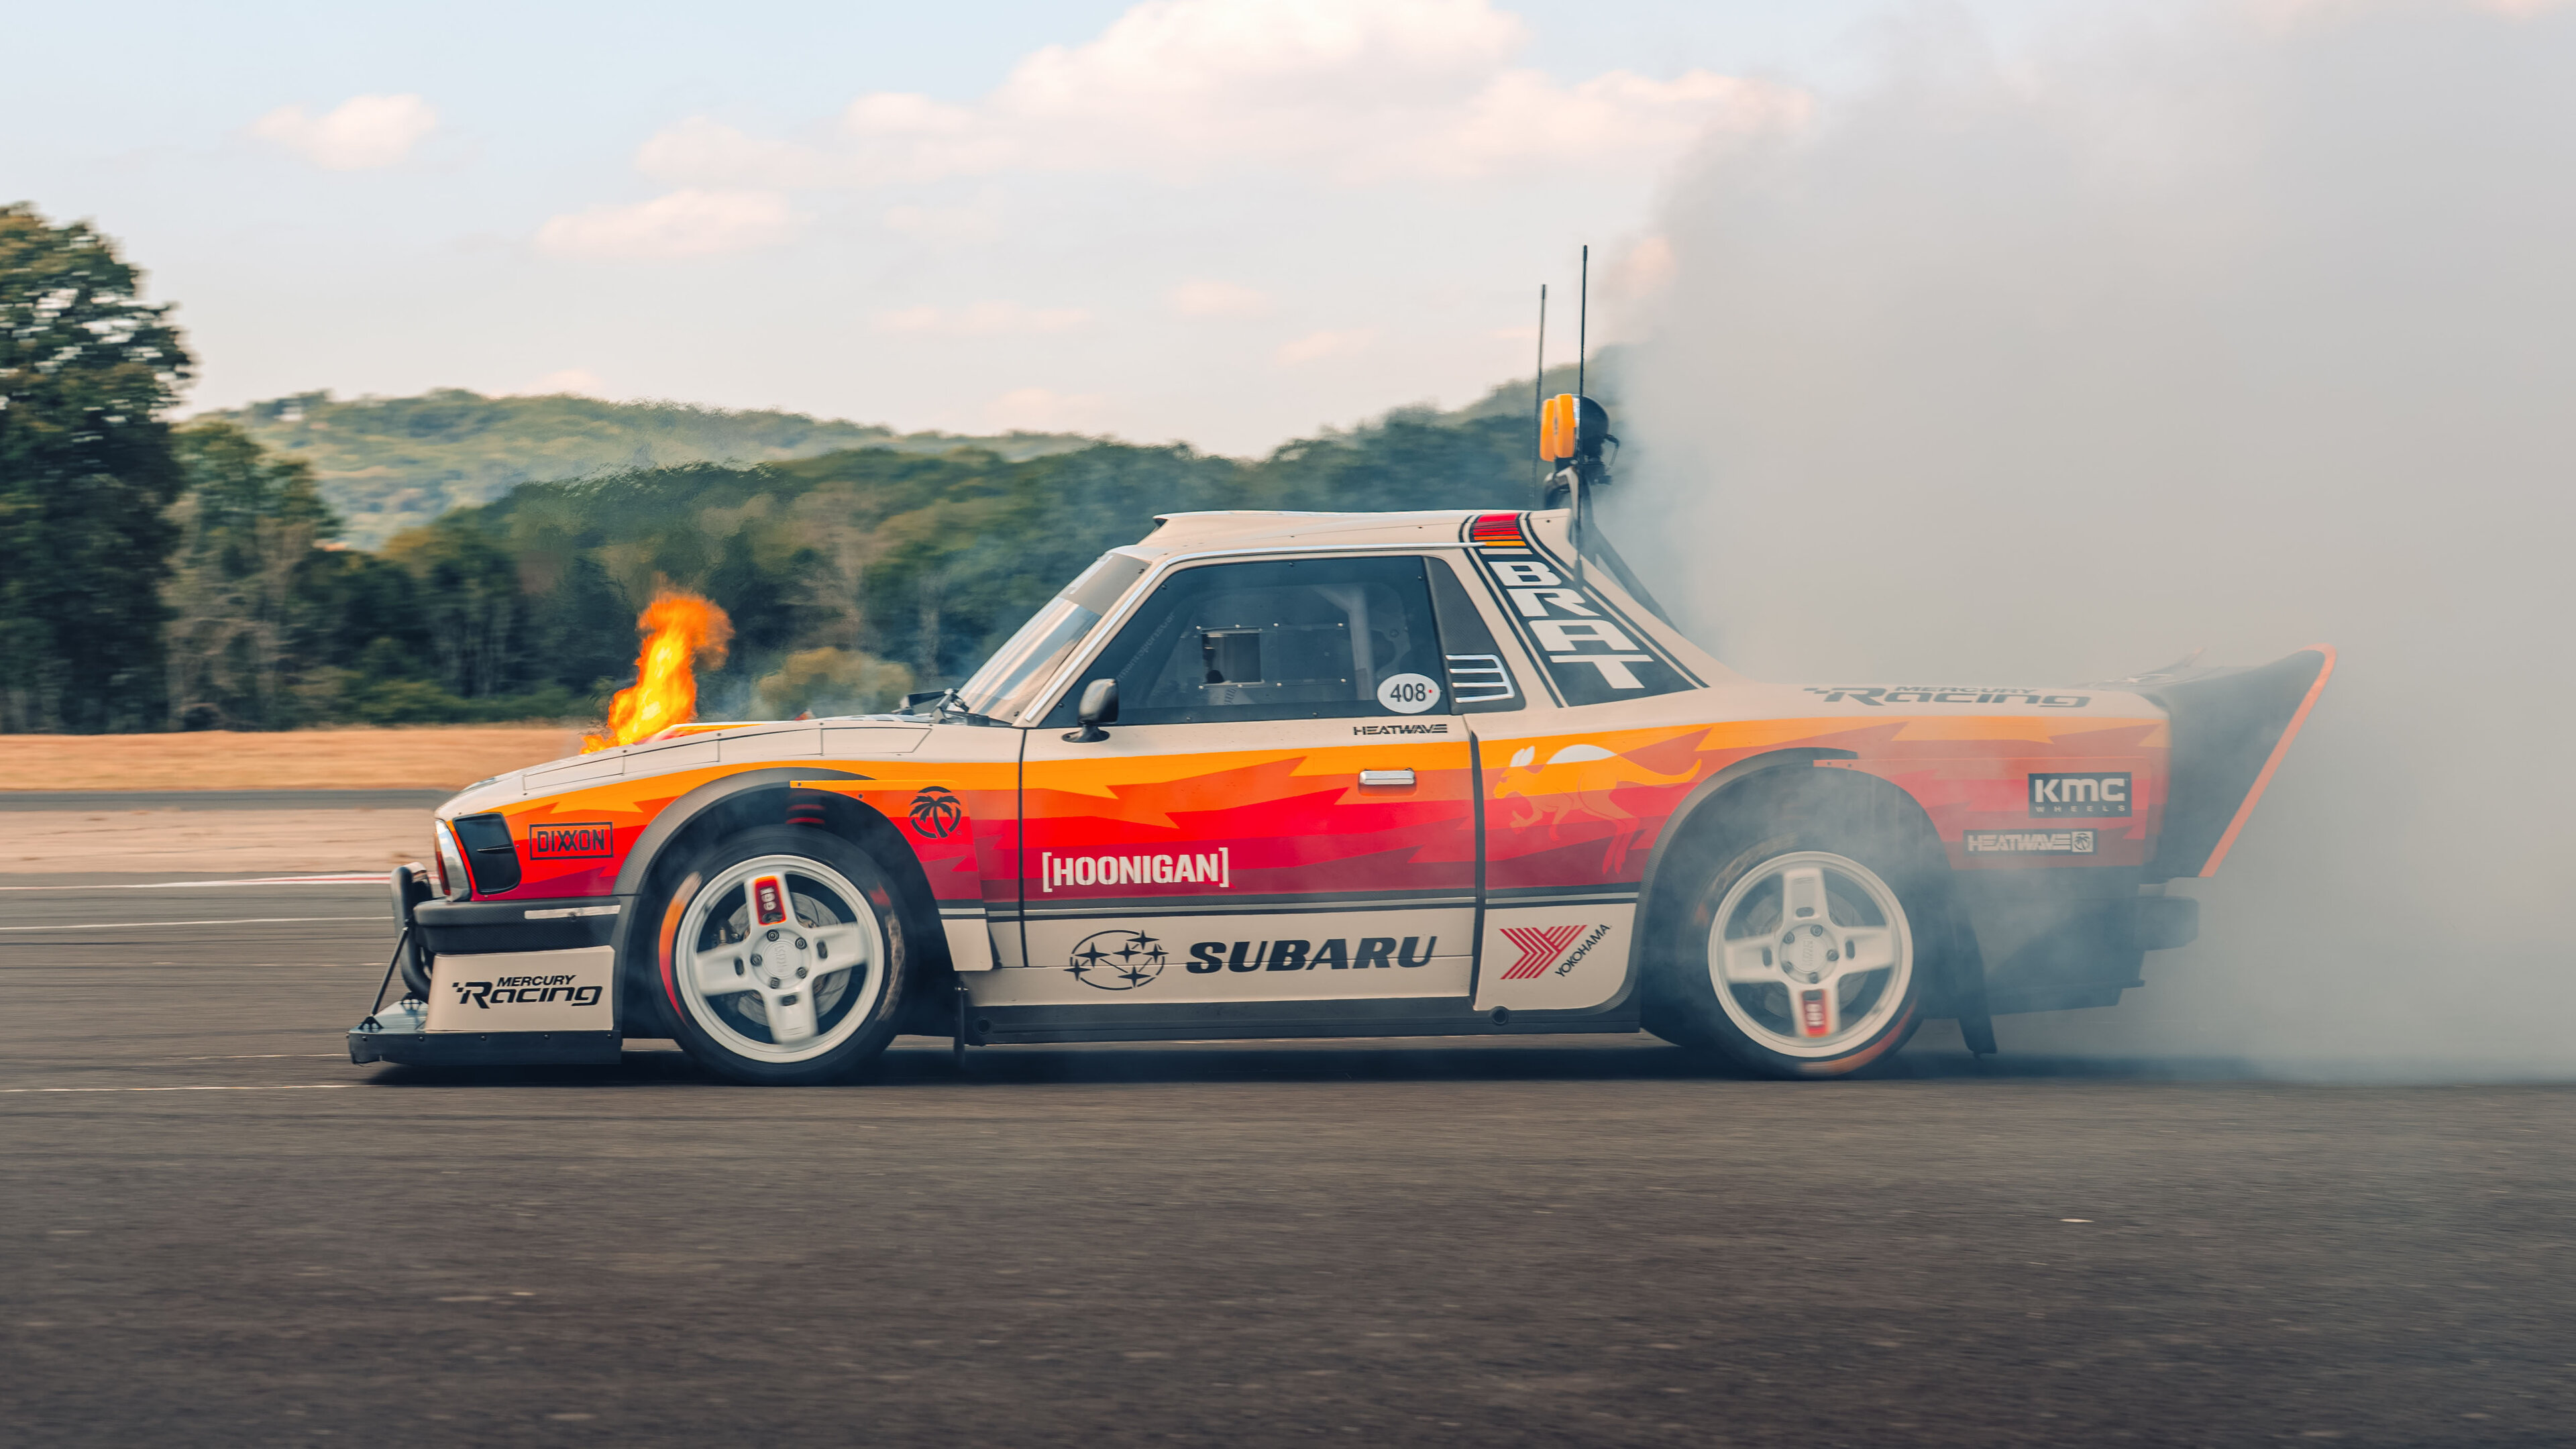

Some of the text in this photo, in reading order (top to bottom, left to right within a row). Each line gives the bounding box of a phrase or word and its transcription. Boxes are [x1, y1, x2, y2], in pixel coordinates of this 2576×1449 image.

[1488, 561, 1654, 689] BRAT
[1390, 683, 1426, 702] 408
[1821, 688, 2092, 708] Racing
[1894, 686, 2038, 694] MERCURY
[1353, 724, 1448, 736] HEATWAVE
[2035, 778, 2126, 803] KMC
[2035, 805, 2126, 813] WHEELS
[537, 829, 604, 852] DIXXON
[1968, 833, 2072, 852] HEATWAVE
[1042, 847, 1230, 893] [HOONIGAN]
[1186, 936, 1438, 974] SUBARU
[1554, 924, 1611, 977] YOKOHAMA
[496, 975, 577, 987] MERCURY
[459, 981, 603, 1010] Racing
